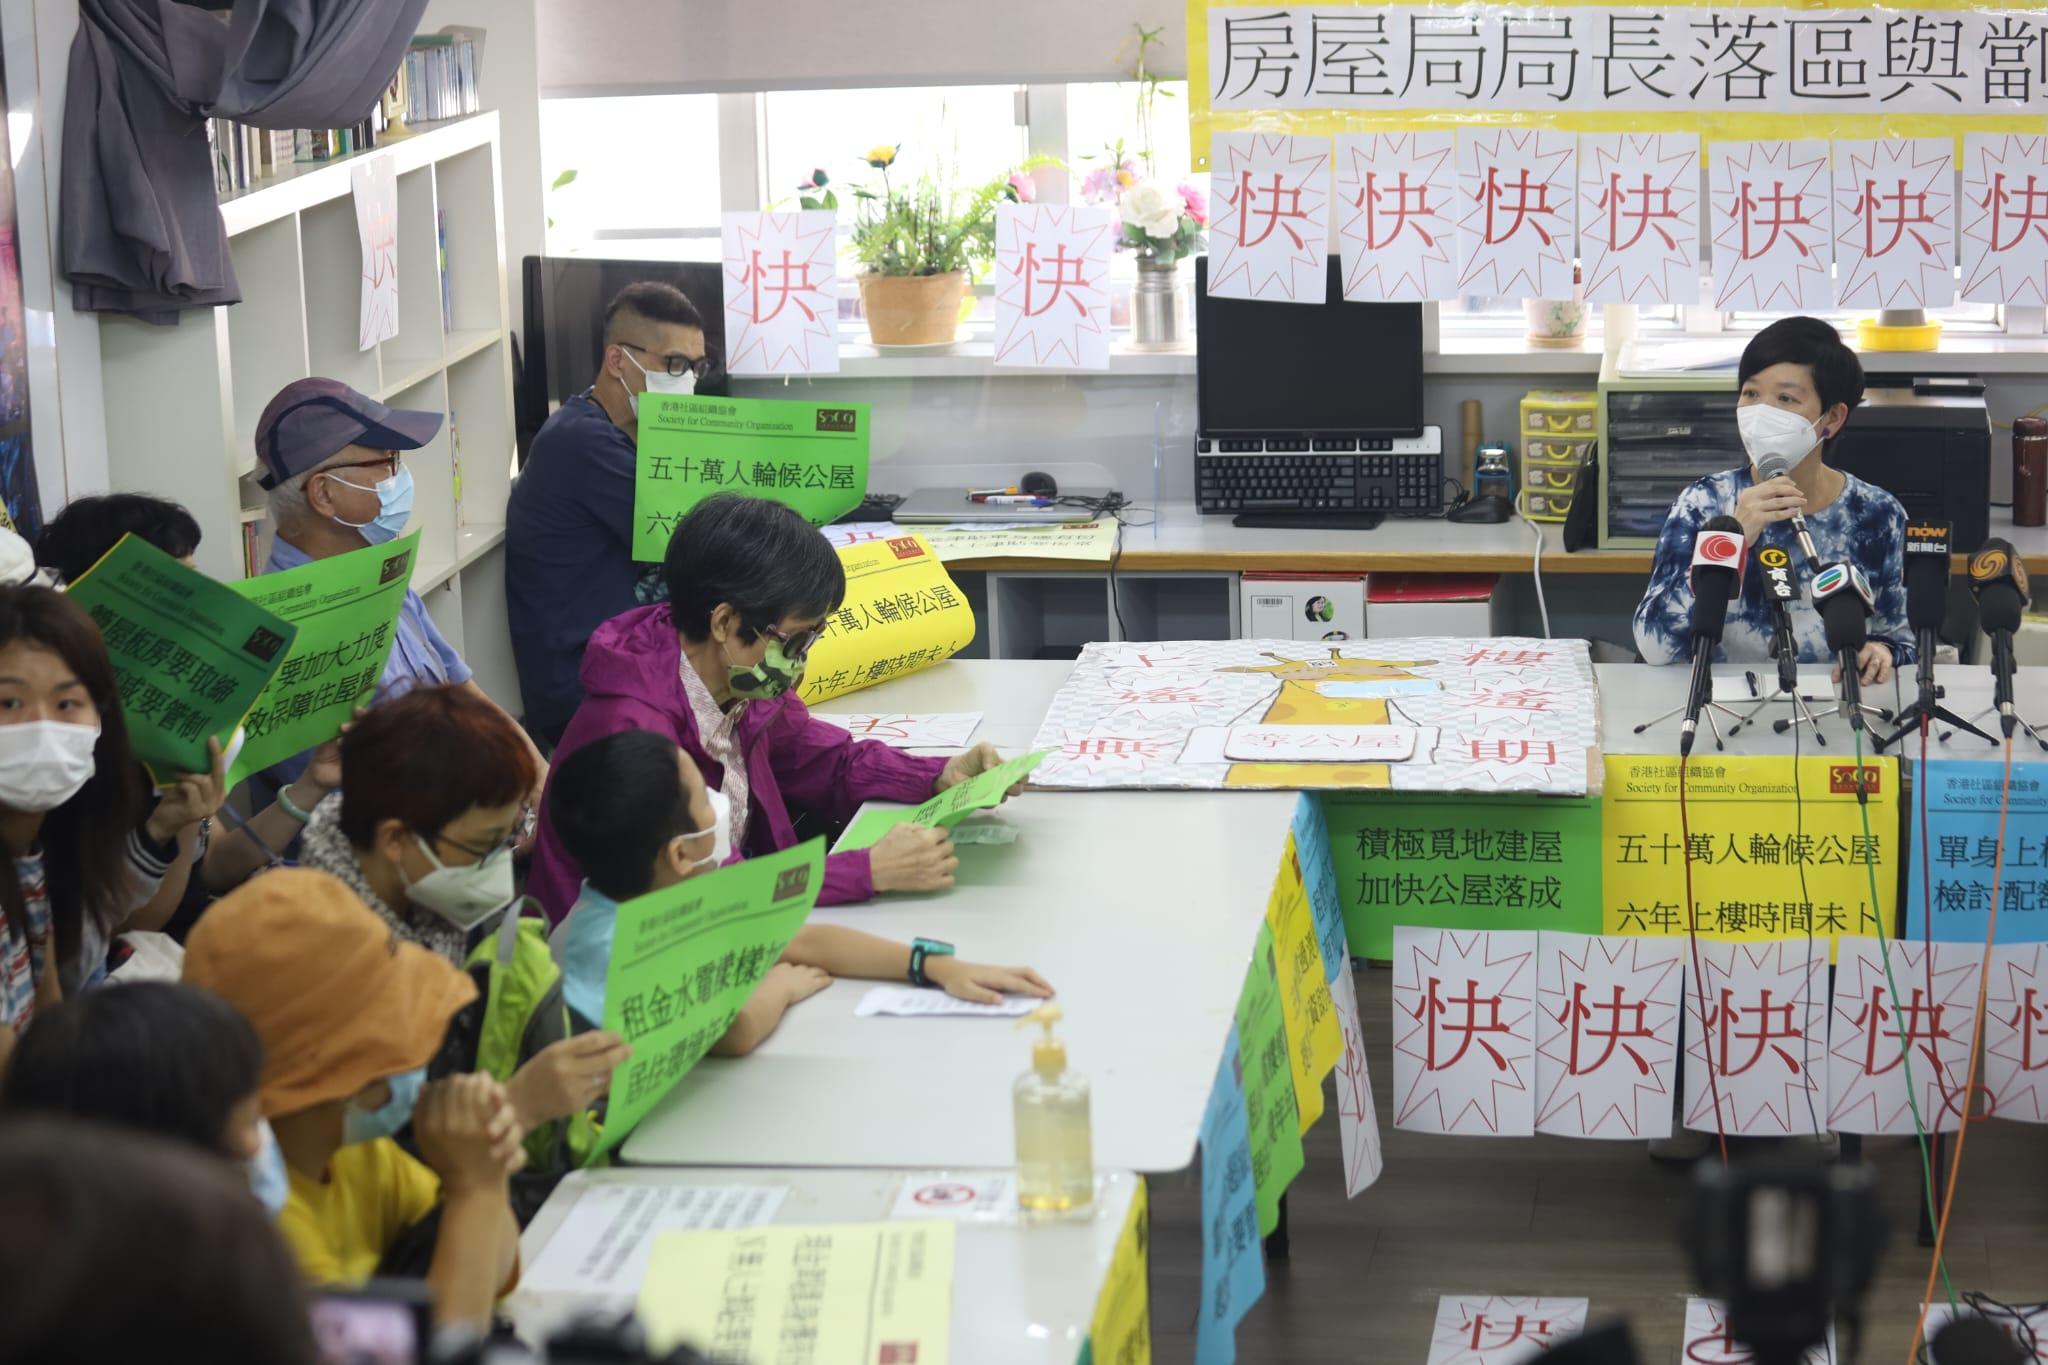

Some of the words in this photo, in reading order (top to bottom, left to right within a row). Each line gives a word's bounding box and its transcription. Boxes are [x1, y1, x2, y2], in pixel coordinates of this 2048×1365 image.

[1215, 11, 2048, 104] 房屋局局長落區與當
[1229, 170, 1307, 250] 快
[1355, 171, 1436, 251] 快
[1475, 165, 1555, 247] 快
[1598, 172, 1681, 253] 快
[1729, 180, 1811, 261] 快
[1854, 178, 1935, 259] 快
[743, 249, 816, 324] 快
[1013, 242, 1090, 317] 快
[658, 414, 687, 426] Society
[700, 416, 744, 429] Community
[746, 419, 793, 431] Organization
[648, 456, 855, 490] 五十萬人輪候公屋
[1907, 527, 1947, 537] now
[820, 584, 961, 638] 十萬人輪候公屋
[265, 619, 391, 693] 要加大力度
[1240, 732, 1402, 748] 等公屋
[1461, 738, 1556, 766] 期
[1626, 782, 1661, 794] Society
[1664, 782, 1678, 793] for
[1684, 782, 1736, 794] ommunity
[1943, 793, 1979, 806] Society
[1616, 833, 1882, 866] 五十萬人輪候公屋
[1936, 835, 2048, 868] 單身上
[1356, 872, 1563, 910] 加快公屋落成
[1414, 977, 1511, 1073] 快
[1556, 982, 1654, 1076] 快
[1704, 988, 1802, 1077] 快
[1853, 986, 1951, 1077] 快
[1460, 1314, 1552, 1352] 快
